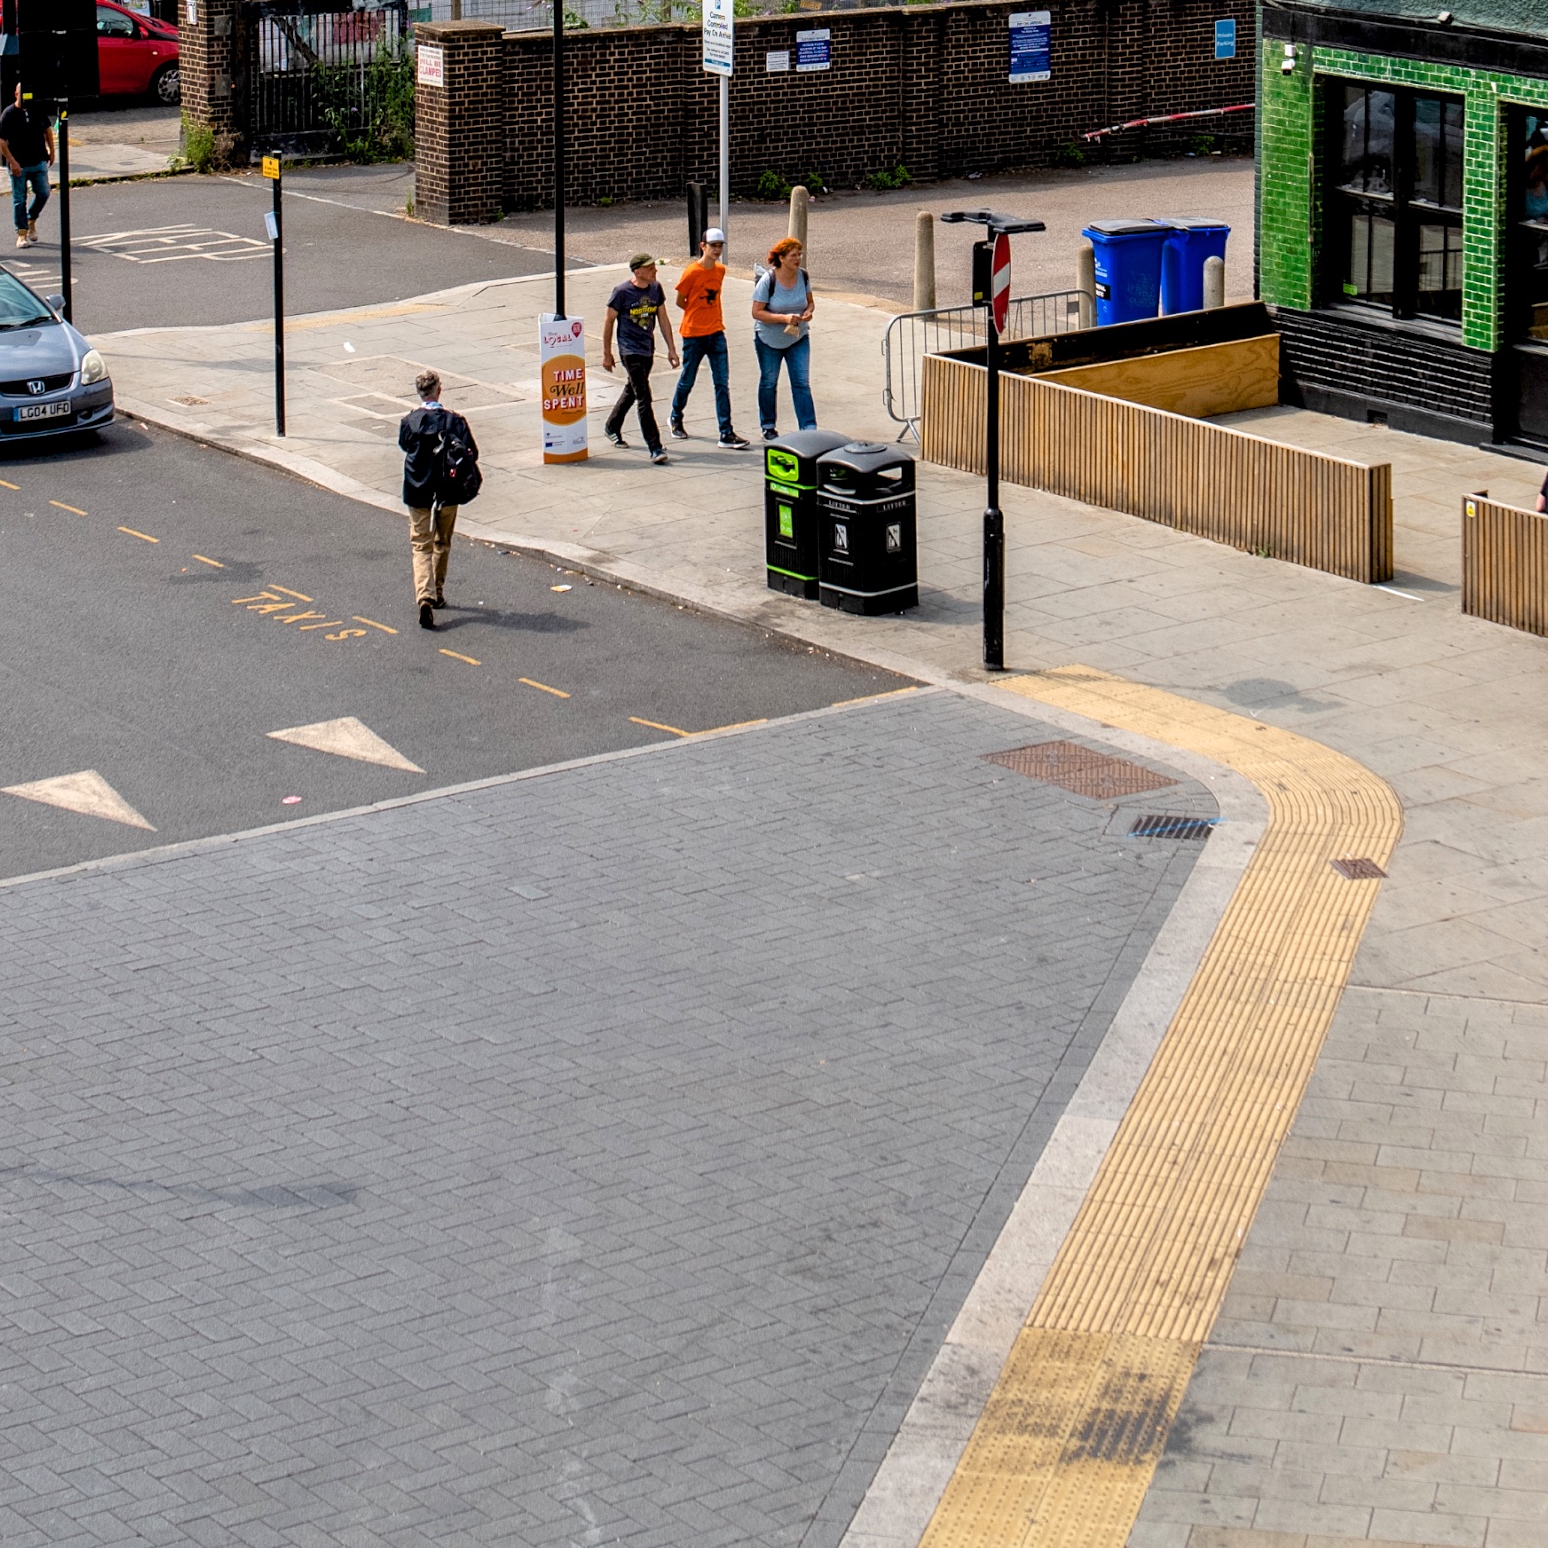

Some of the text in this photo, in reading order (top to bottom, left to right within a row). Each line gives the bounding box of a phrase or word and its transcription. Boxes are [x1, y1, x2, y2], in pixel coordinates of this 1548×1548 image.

[553, 368, 584, 383] TIME
[549, 382, 585, 398] Well
[543, 395, 584, 411] SPENT
[231, 591, 368, 641] TAXIS
